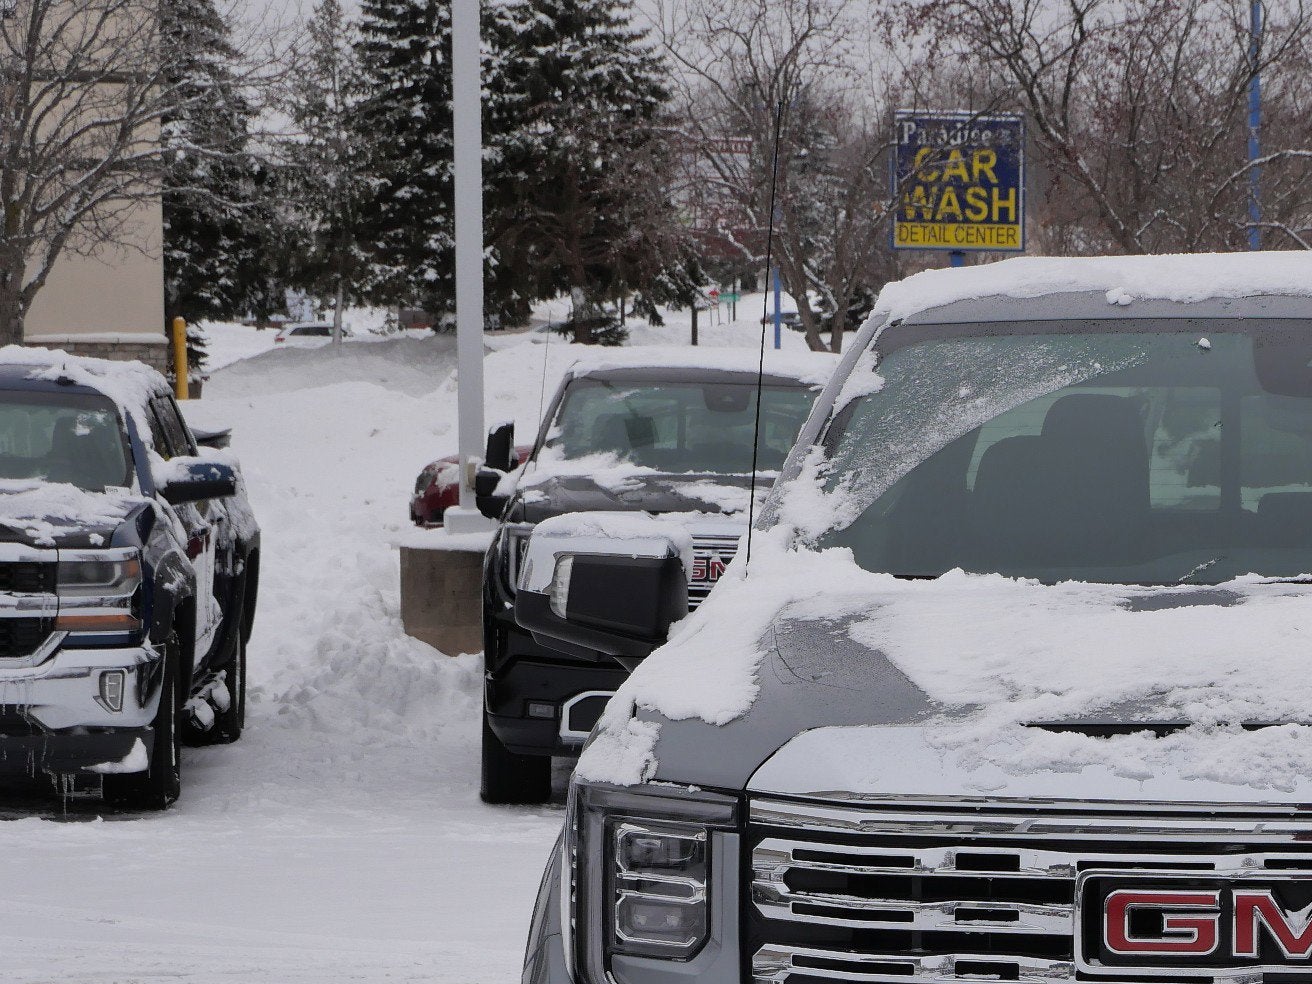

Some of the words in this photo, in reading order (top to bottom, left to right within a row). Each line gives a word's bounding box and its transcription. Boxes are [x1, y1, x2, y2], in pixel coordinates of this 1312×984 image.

[914, 147, 998, 184] CAR
[904, 185, 1016, 222] WASH
[898, 225, 951, 243] DETAIL
[955, 225, 1017, 244] CENTER
